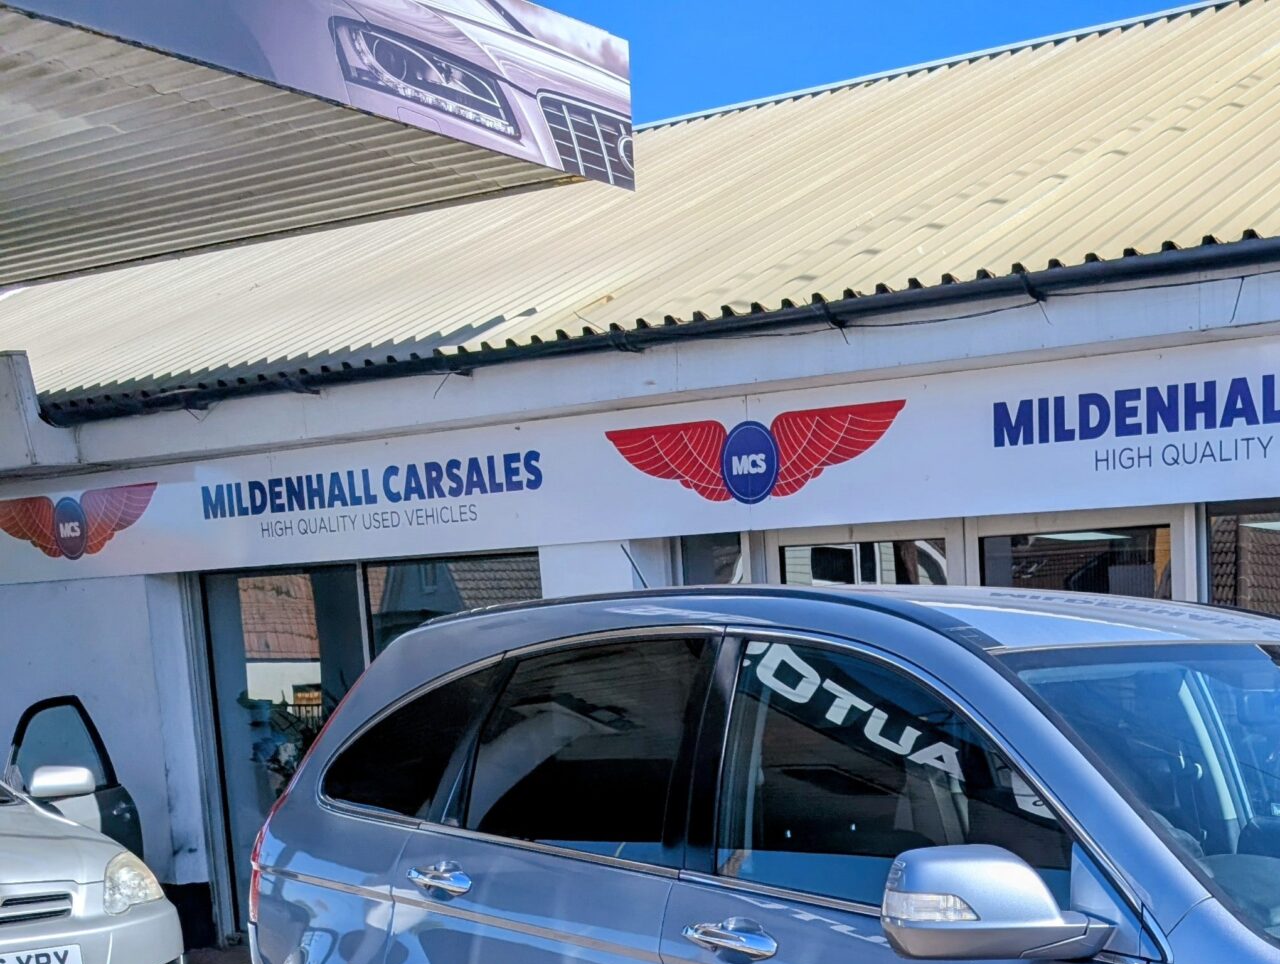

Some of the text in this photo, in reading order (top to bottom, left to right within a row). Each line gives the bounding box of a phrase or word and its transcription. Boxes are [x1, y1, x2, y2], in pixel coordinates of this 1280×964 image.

[731, 453, 767, 476] MCS
[1094, 446, 1153, 472] HIGH
[1161, 436, 1274, 467] QUALITY
[201, 450, 543, 520] MILDENHALL CARSALES
[59, 521, 81, 540] MCS
[260, 504, 478, 539] HIGH QUALITY USED VEHICLES
